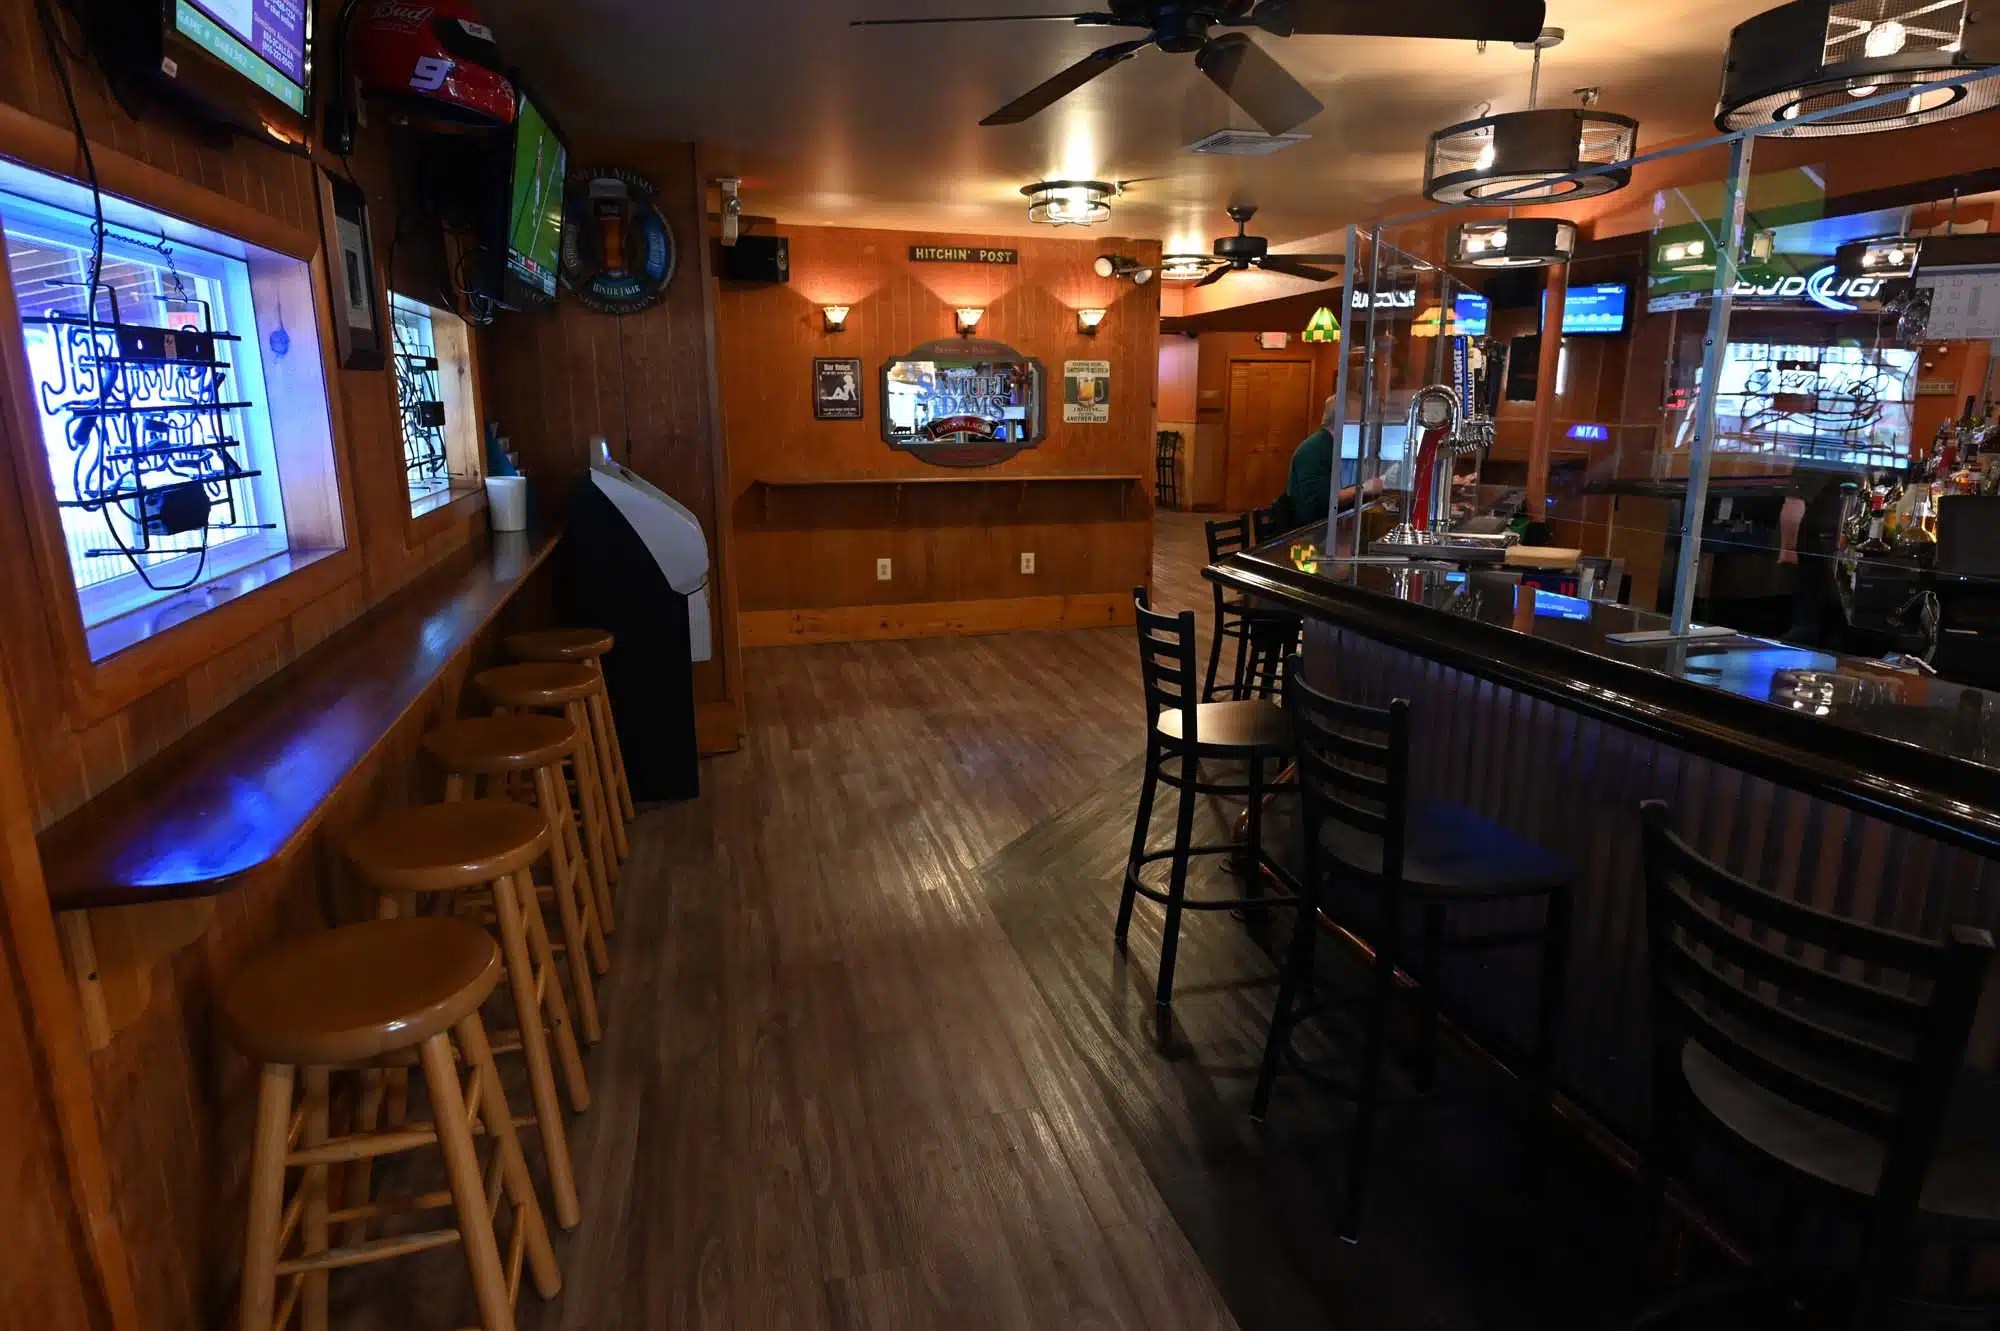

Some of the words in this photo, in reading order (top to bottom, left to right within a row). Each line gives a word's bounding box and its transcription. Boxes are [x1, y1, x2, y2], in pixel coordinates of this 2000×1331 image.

[408, 55, 450, 90] 9
[915, 247, 971, 260] HITCHIN'
[979, 250, 1013, 262] POST
[1453, 348, 1463, 383] LIGHT
[917, 372, 1012, 401] SAMUEL
